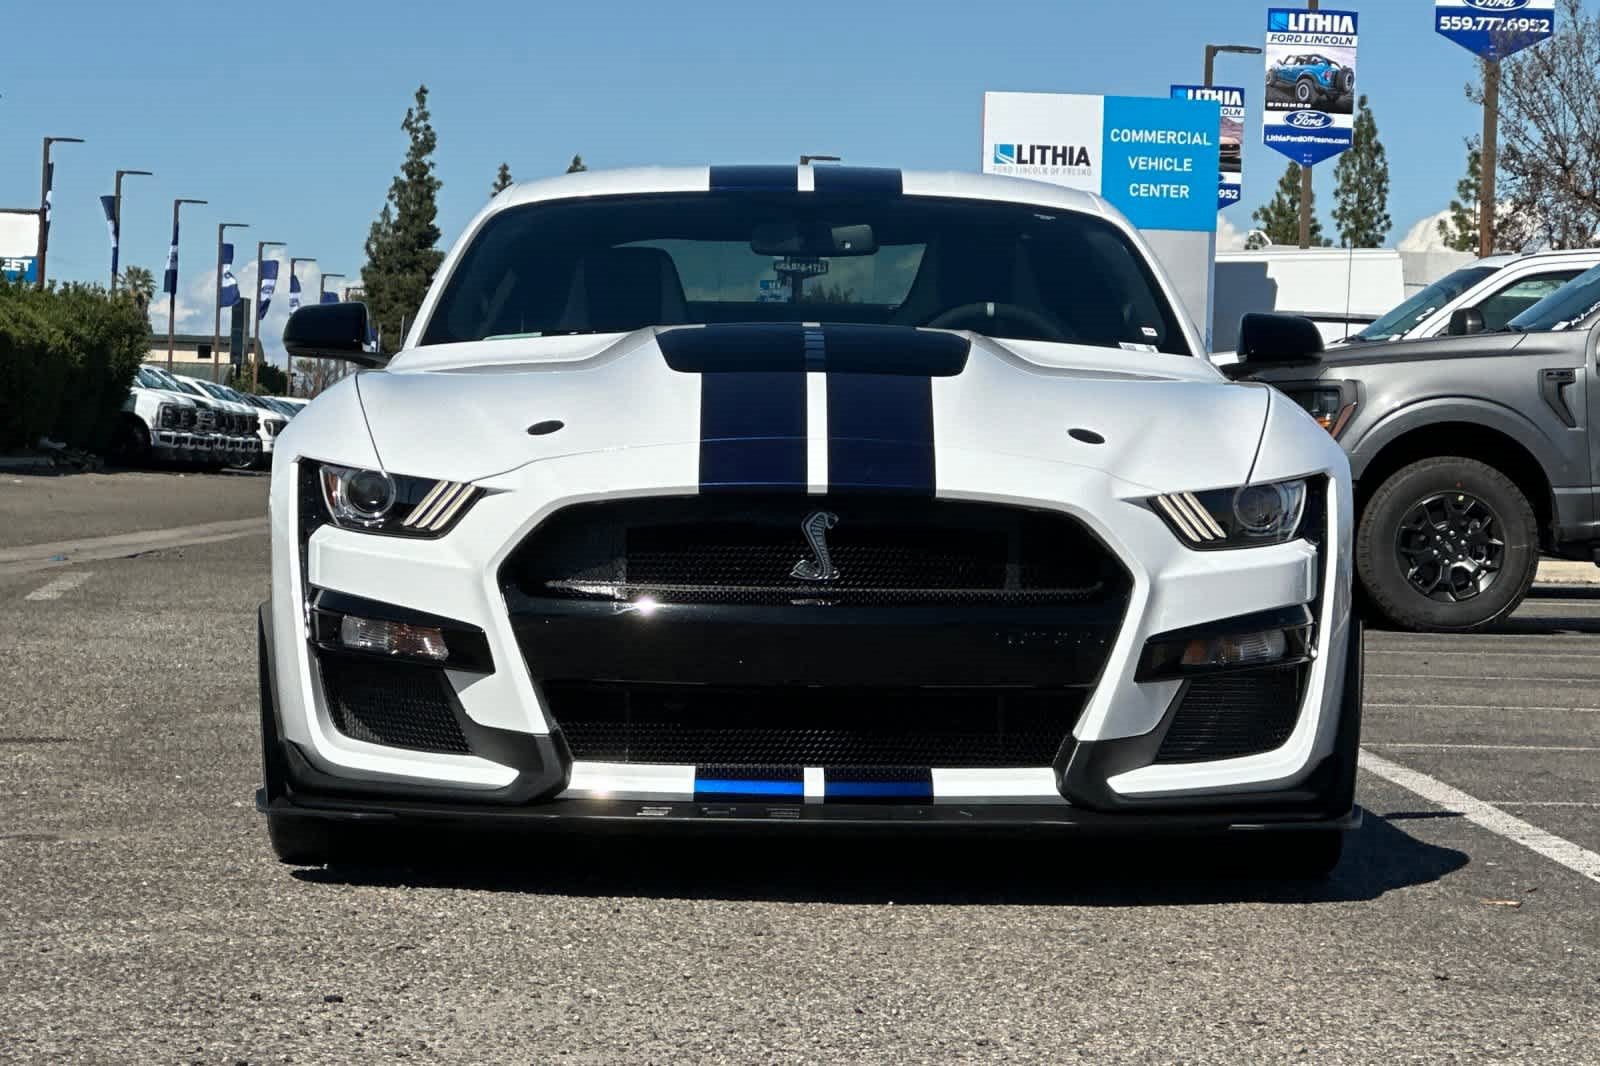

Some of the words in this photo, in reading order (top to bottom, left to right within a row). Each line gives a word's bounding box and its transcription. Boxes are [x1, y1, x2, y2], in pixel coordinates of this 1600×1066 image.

[1287, 13, 1355, 33] LITHIA
[1439, 16, 1550, 33] 559.777.6952
[1270, 34, 1303, 43] FORD
[1303, 35, 1354, 45] LINCOLN
[1221, 107, 1242, 116] OLN
[1292, 112, 1325, 127] Ford
[1110, 128, 1213, 146] COMMERCIAL
[1016, 144, 1091, 167] LITHIA
[1128, 155, 1193, 172] VEHICLE
[1129, 183, 1190, 199] CENTER
[1218, 189, 1239, 199] 952
[0, 258, 33, 272] EET
